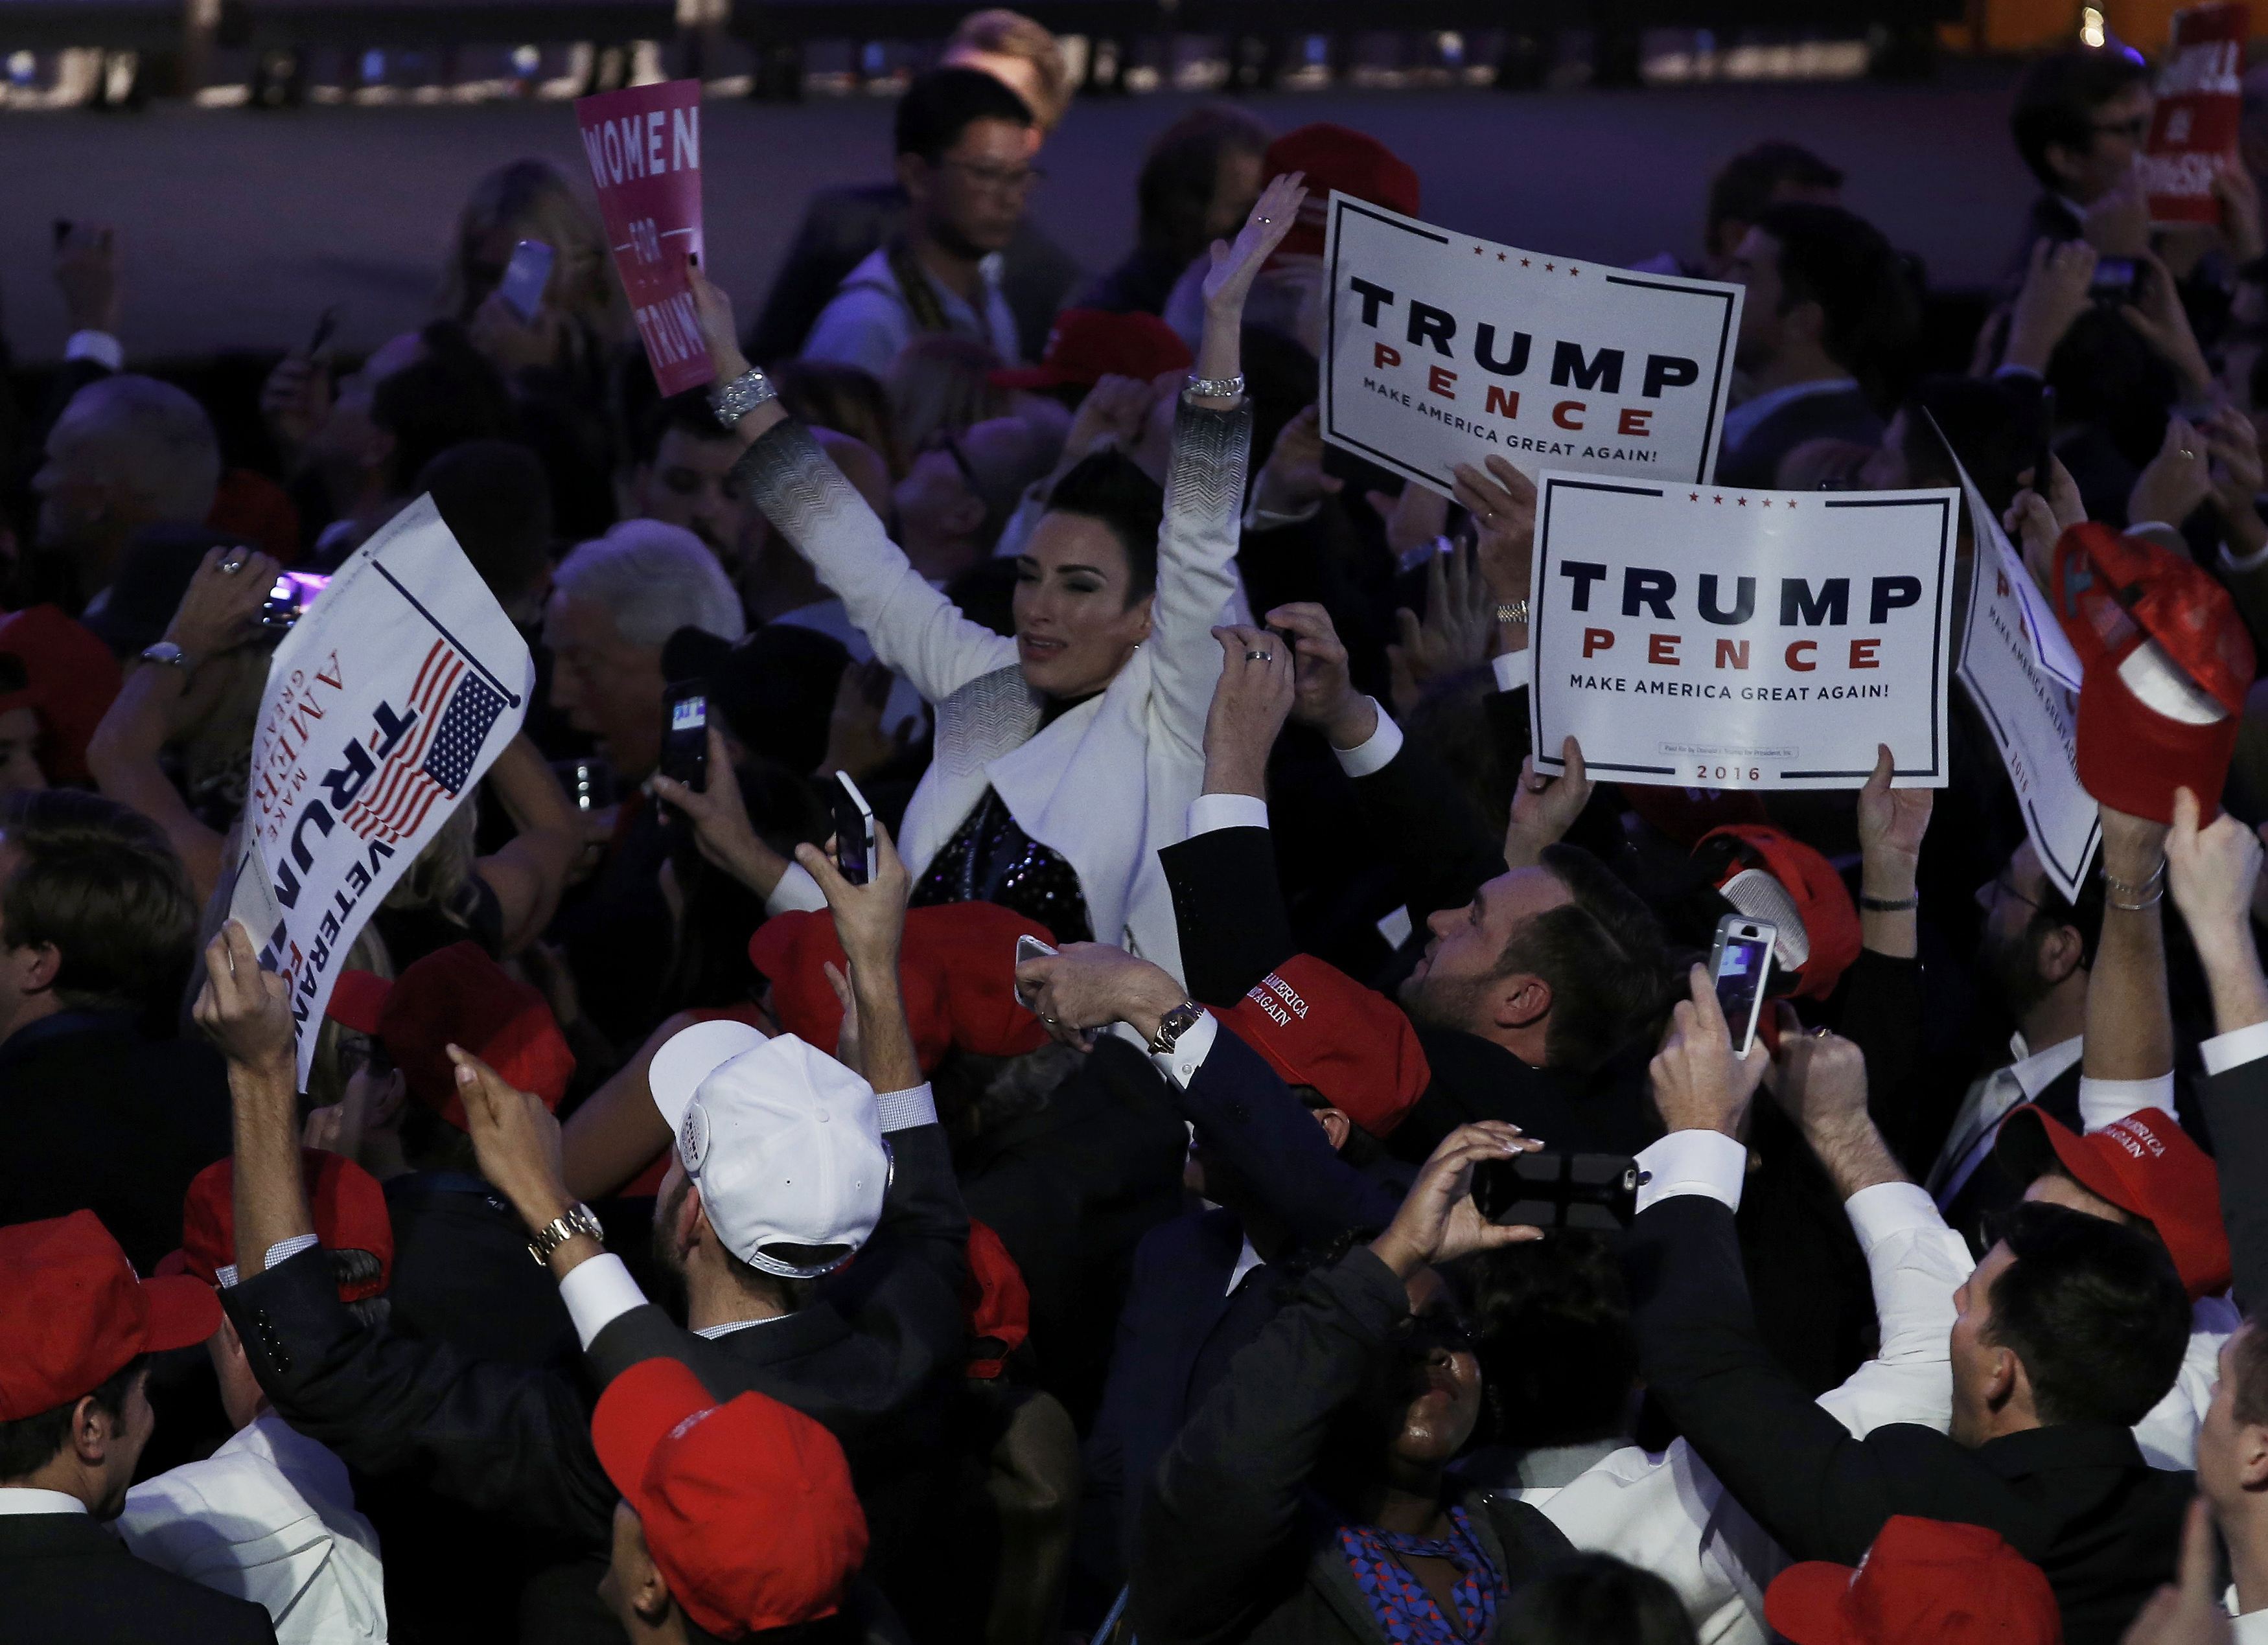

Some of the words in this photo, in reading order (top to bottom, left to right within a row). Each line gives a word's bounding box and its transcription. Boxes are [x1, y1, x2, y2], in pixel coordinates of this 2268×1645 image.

[581, 106, 700, 189] WOMEN
[636, 292, 706, 369] TRUM
[1350, 276, 1699, 398] TRUMP
[1363, 376, 1411, 408] MAKE
[1417, 402, 1498, 443] AMERICA
[1507, 434, 1575, 455] GREAT
[1582, 445, 1658, 463] AGAIN!
[1374, 341, 1654, 437] PENCE
[1560, 560, 1923, 627] TRUMP
[1569, 674, 1626, 692] MAKE
[1634, 680, 1732, 700] AMERICA
[1741, 687, 1810, 701] GREAT
[1817, 684, 1890, 700] AGAIN!
[1582, 627, 1882, 673] PENCE
[1696, 765, 1760, 781] 2016
[292, 838, 396, 1057] VETERAN
